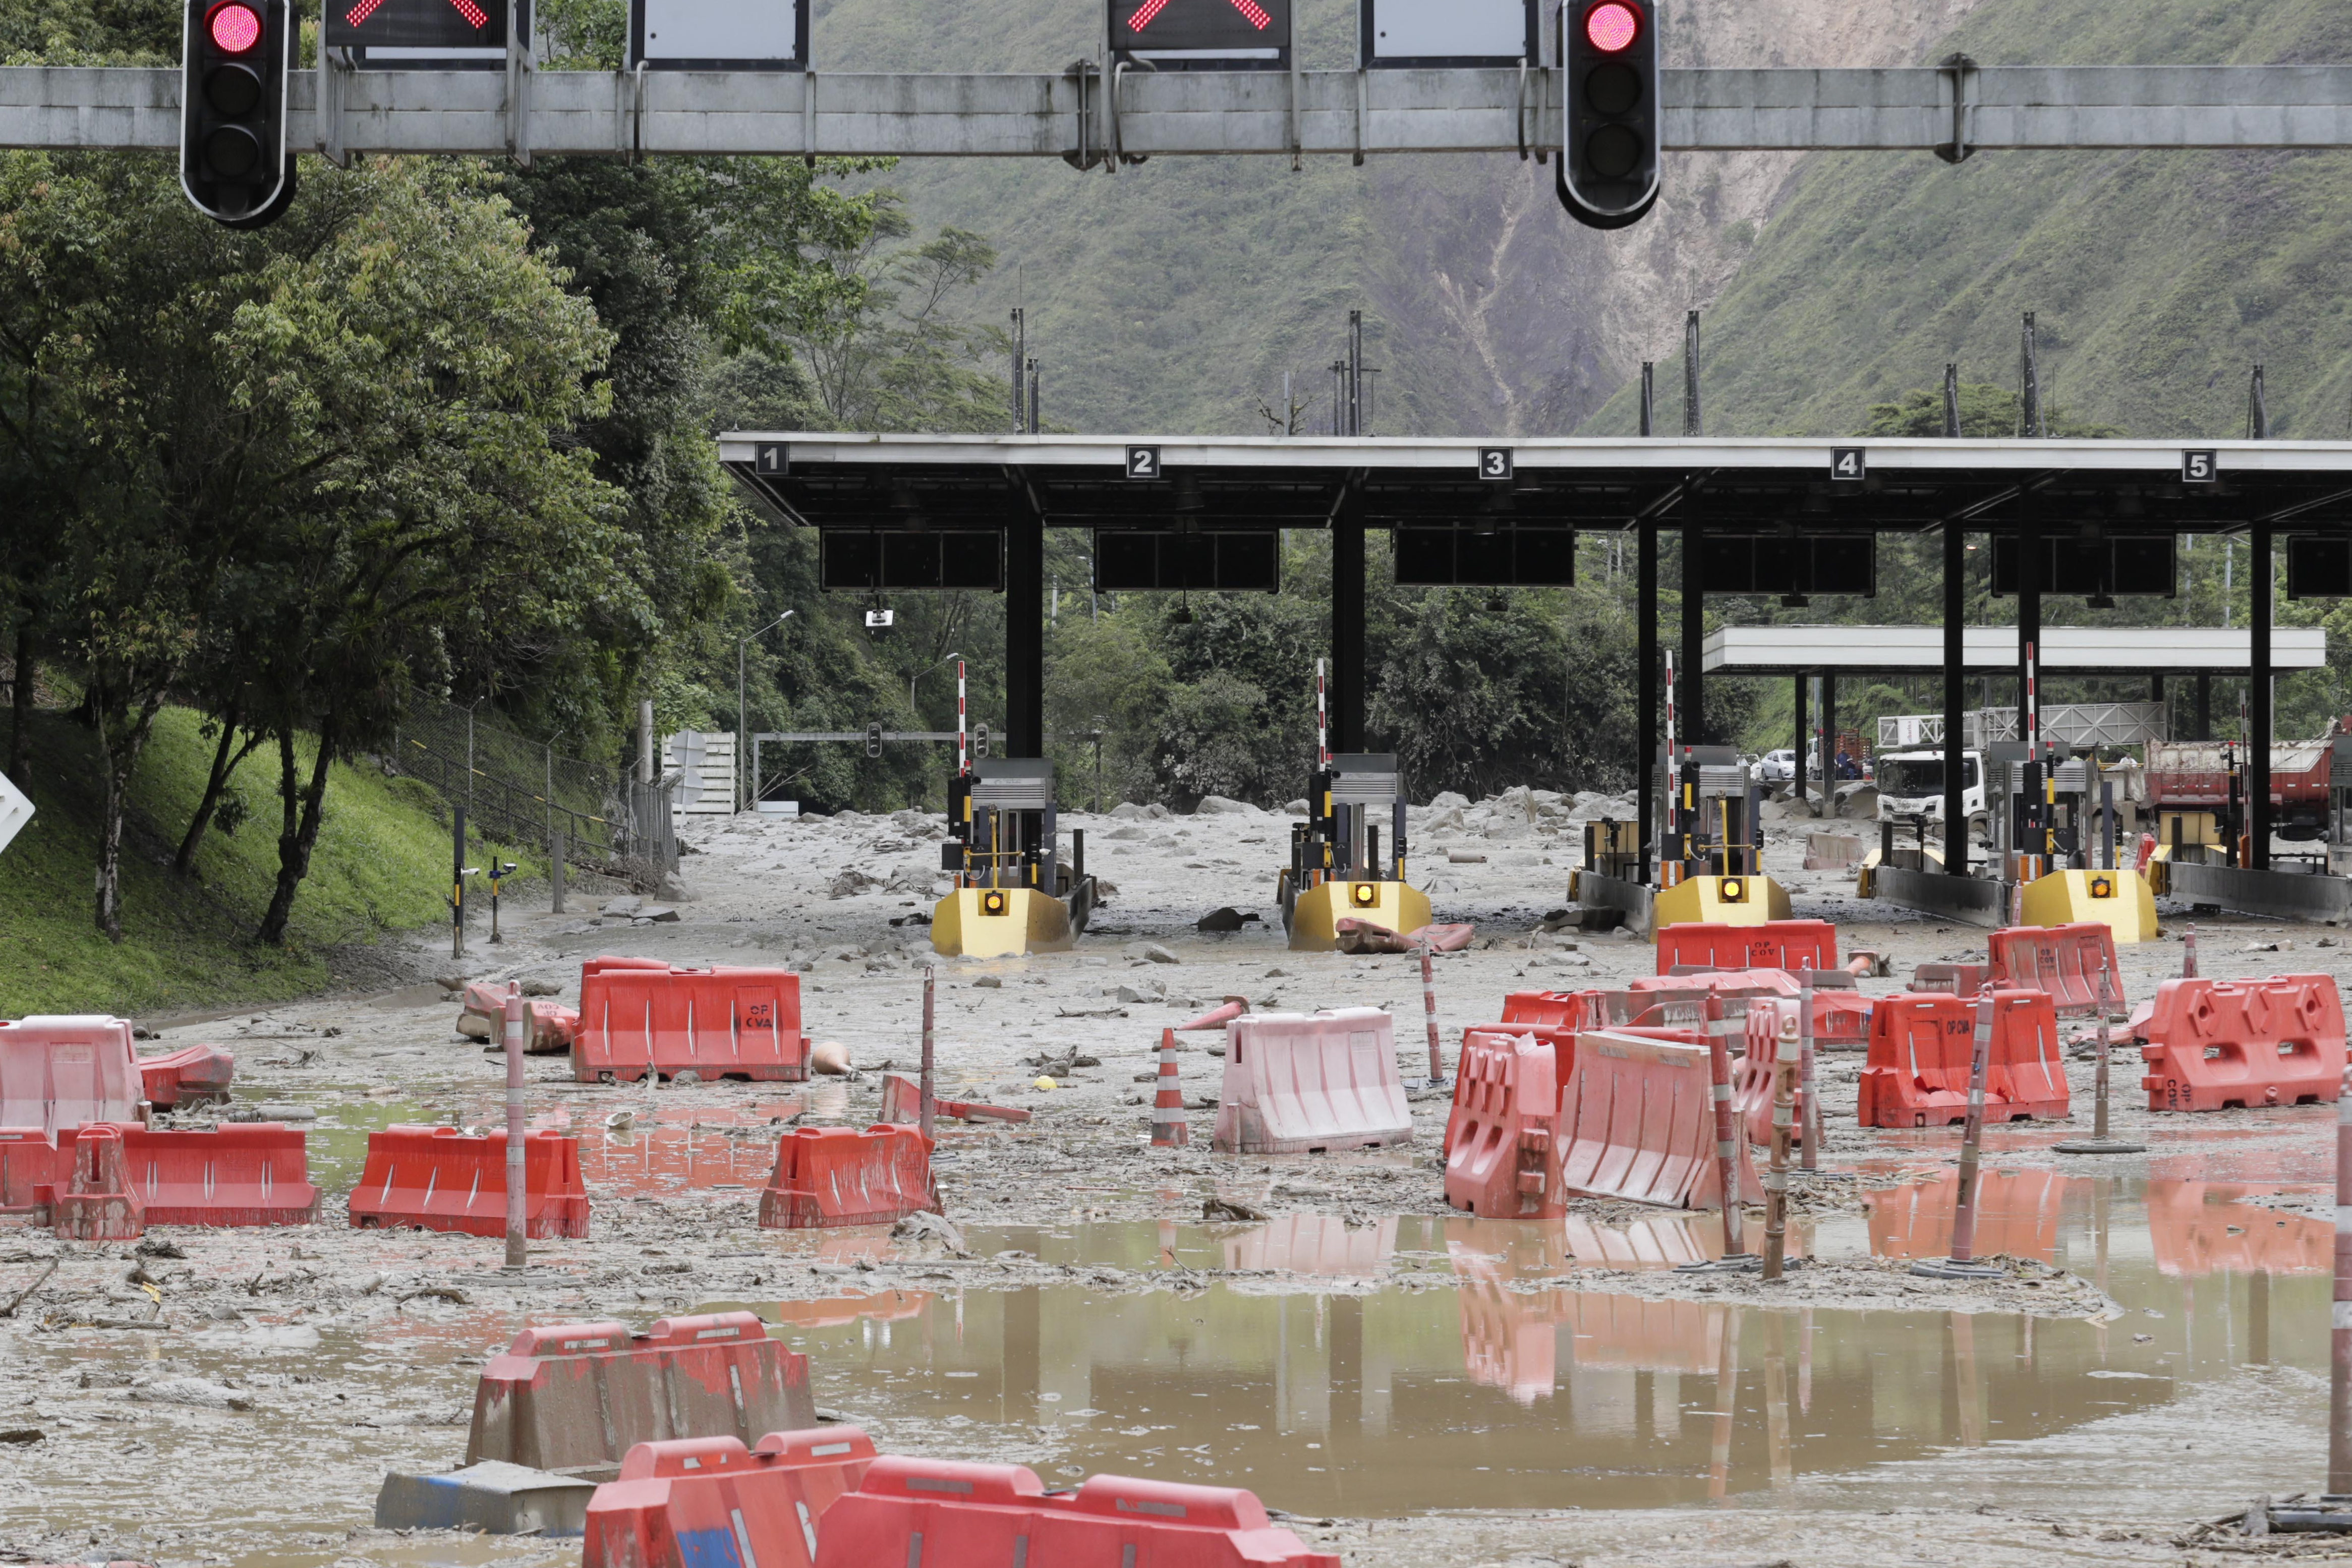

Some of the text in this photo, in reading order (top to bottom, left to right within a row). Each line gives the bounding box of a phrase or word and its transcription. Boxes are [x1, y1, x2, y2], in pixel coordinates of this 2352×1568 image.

[765, 448, 777, 469] 1
[1134, 450, 1152, 473] 2
[1486, 452, 1505, 475] 3
[1838, 452, 1857, 475] 4
[2190, 455, 2208, 477] 5
[750, 1004, 768, 1015] OP
[746, 1017, 772, 1027] CVA
